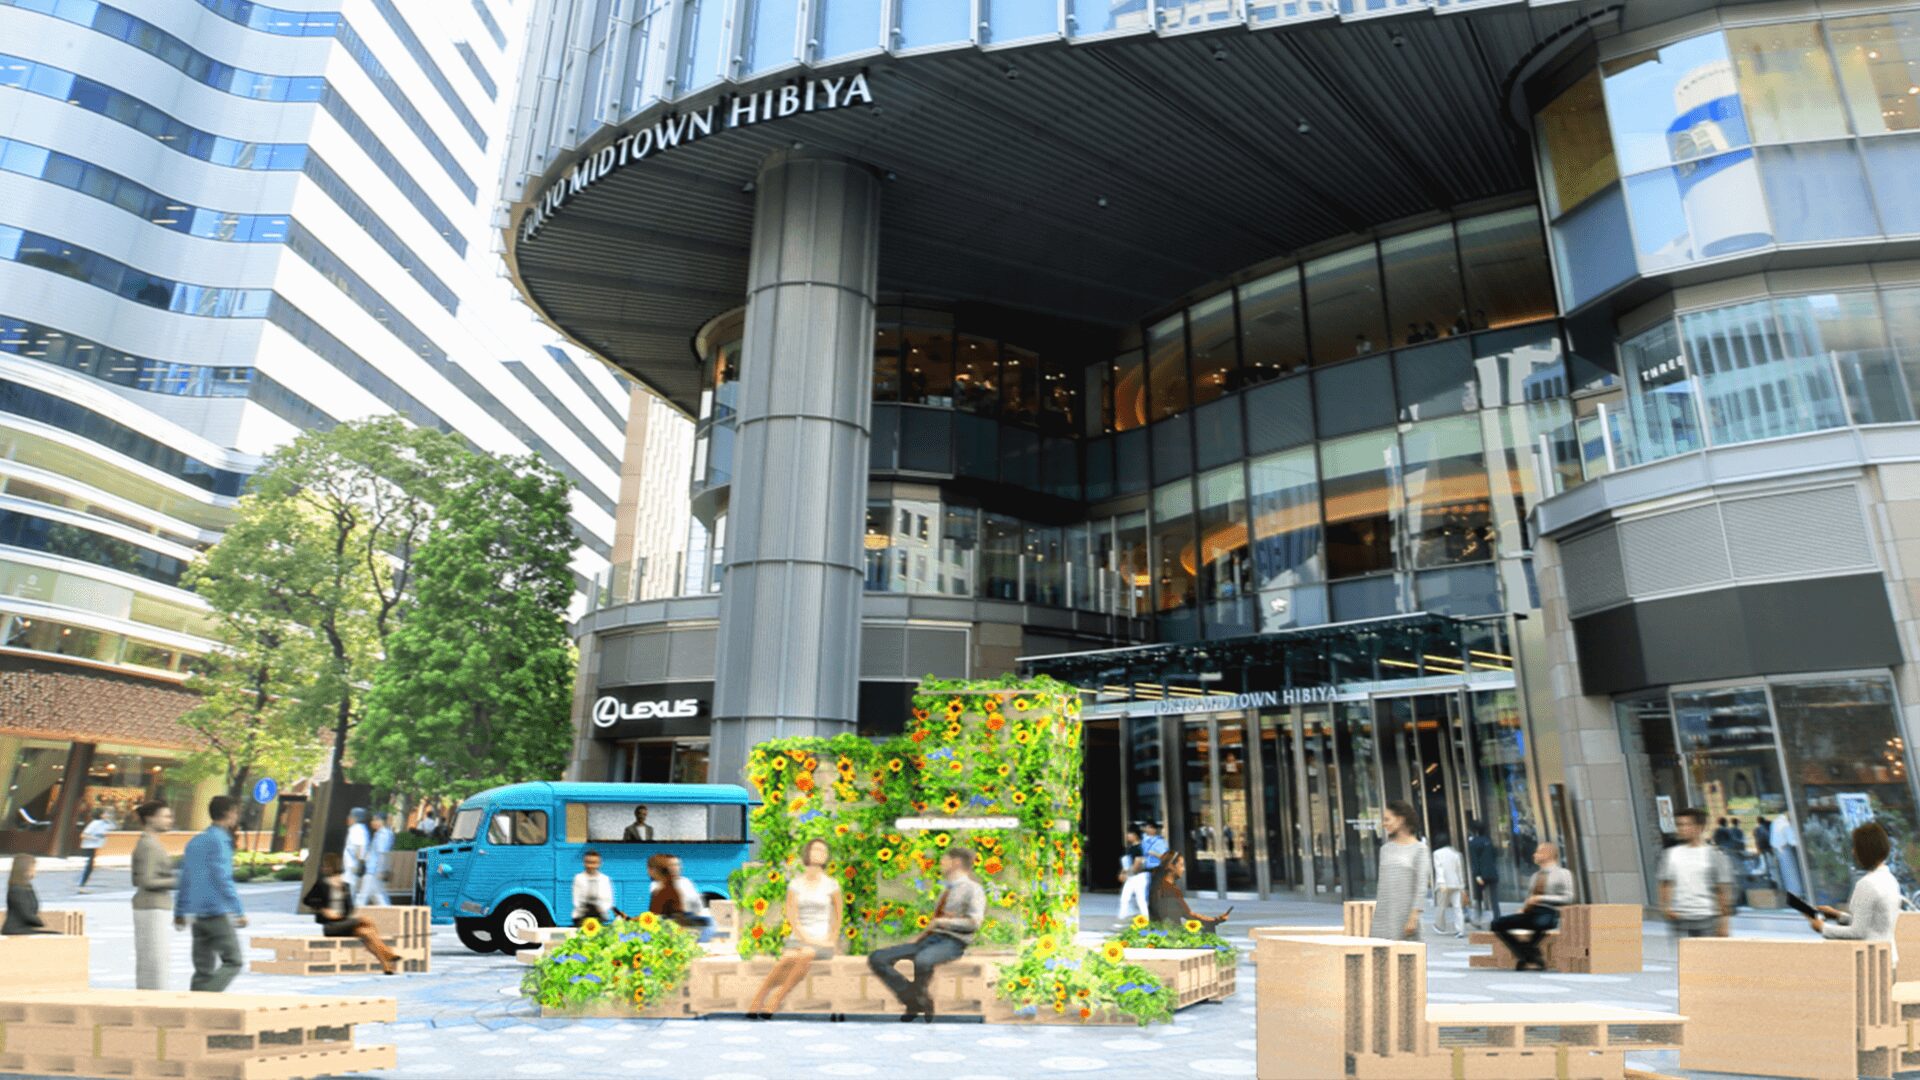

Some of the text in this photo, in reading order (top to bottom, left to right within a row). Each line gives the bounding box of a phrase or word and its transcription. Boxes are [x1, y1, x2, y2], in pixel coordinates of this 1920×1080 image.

[568, 104, 714, 196] MIDTOWN
[730, 74, 872, 128] HIBIYA
[1641, 354, 1684, 381] THREE
[1283, 686, 1338, 704] HIBIYA
[620, 698, 698, 720] LEXUS
